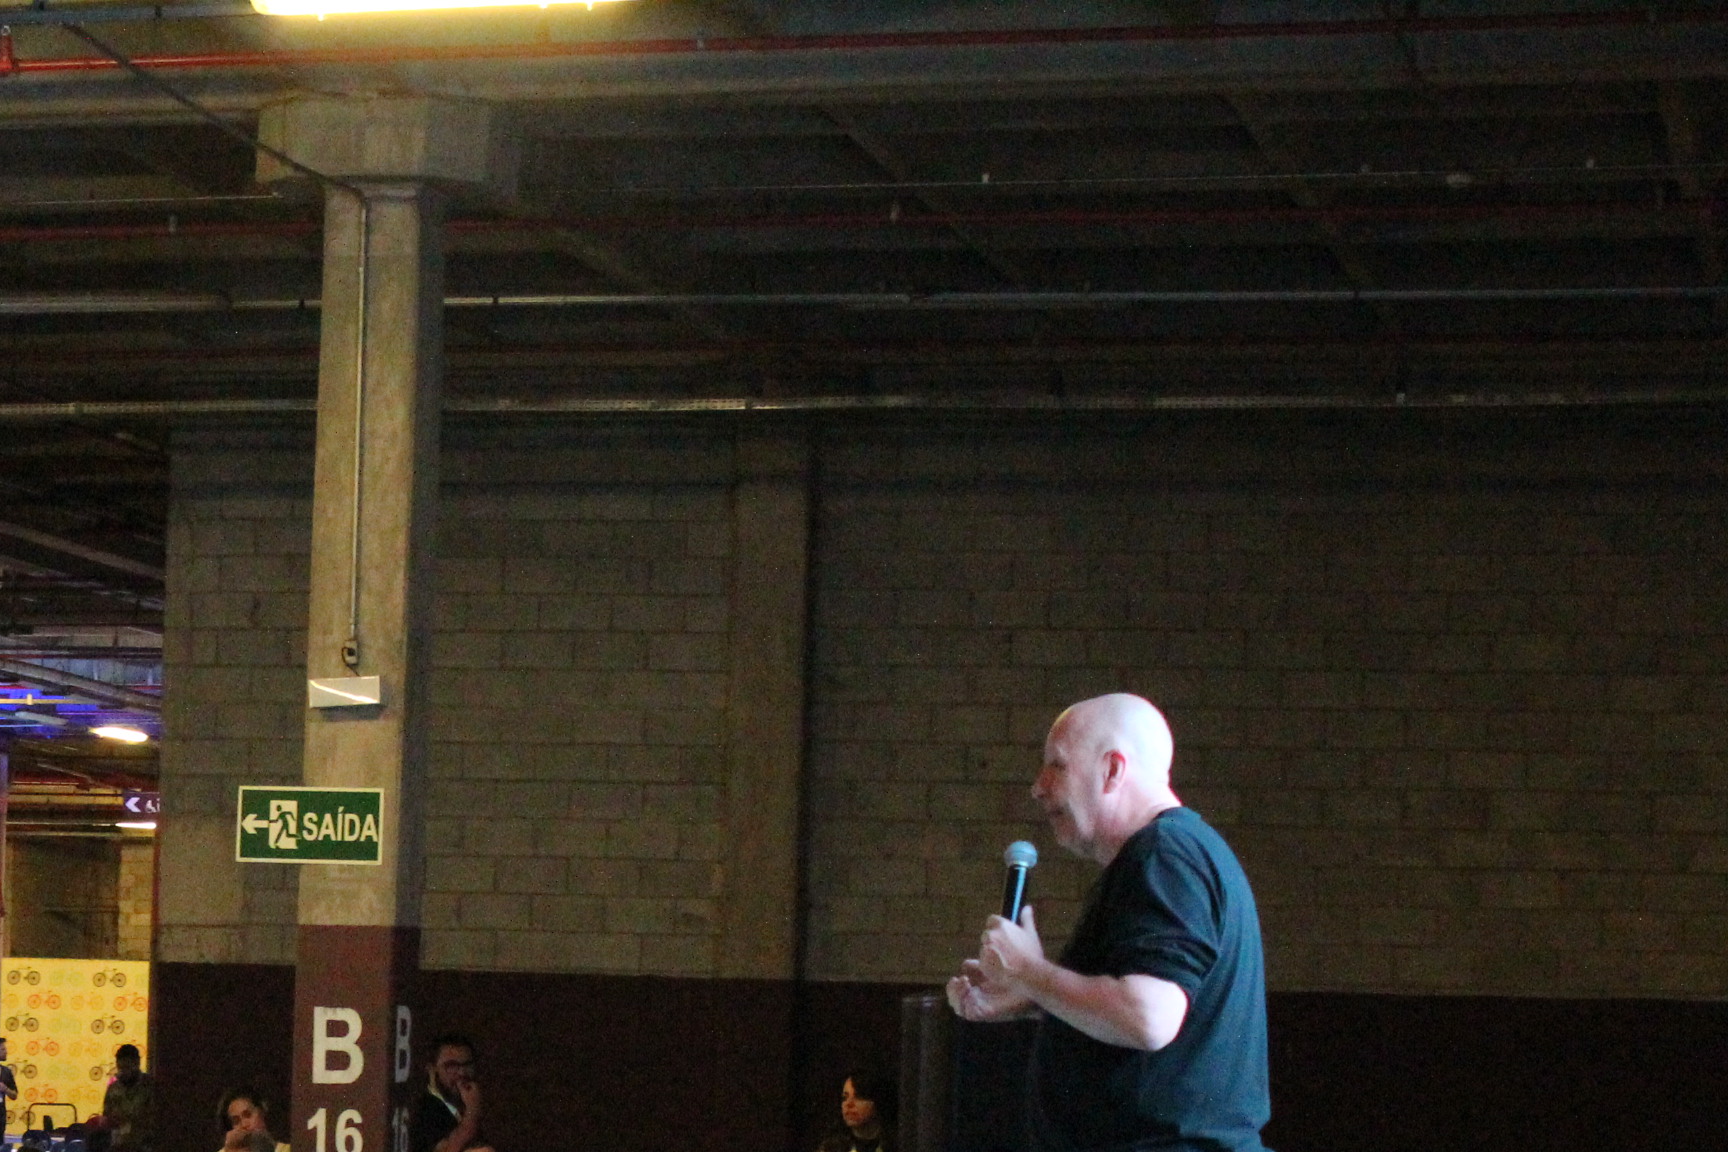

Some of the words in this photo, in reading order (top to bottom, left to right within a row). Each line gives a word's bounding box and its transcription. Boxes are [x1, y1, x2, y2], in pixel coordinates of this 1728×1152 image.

[302, 806, 378, 842] SAÍDA
[311, 1005, 365, 1084] B
[394, 1005, 412, 1083] B
